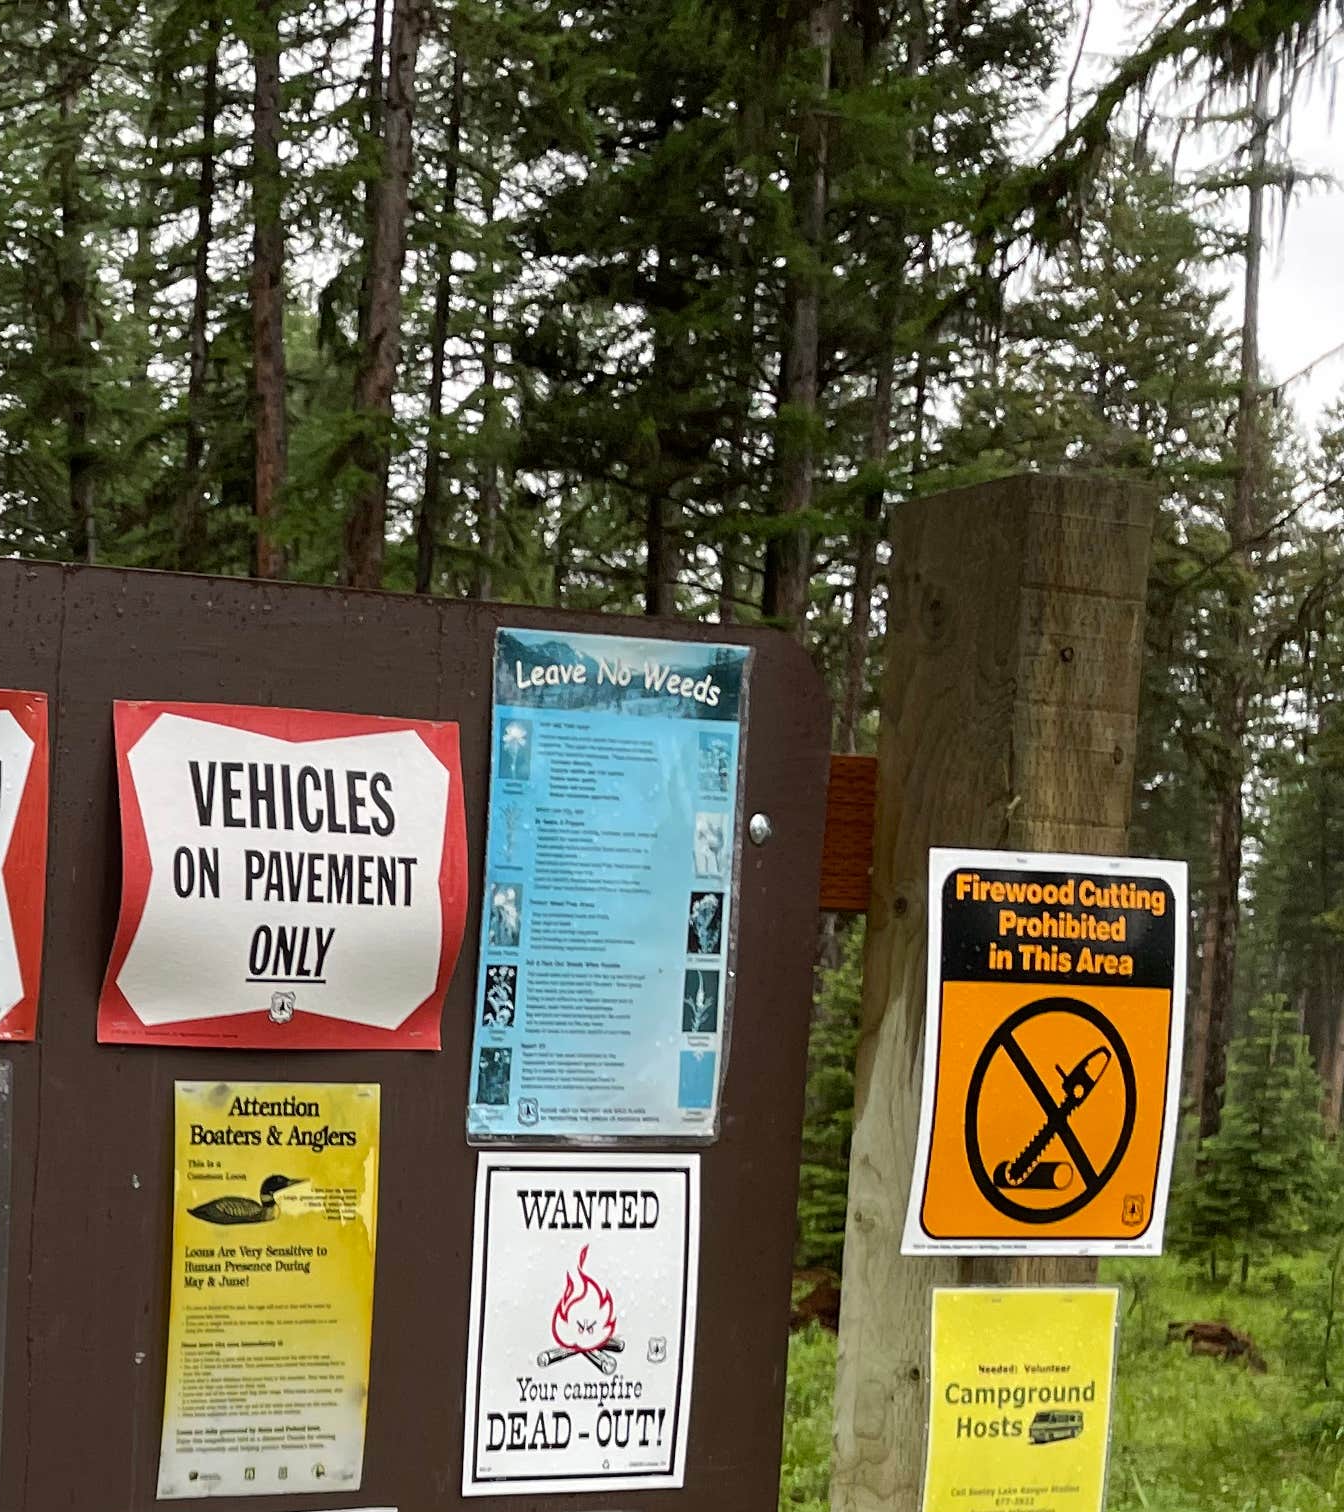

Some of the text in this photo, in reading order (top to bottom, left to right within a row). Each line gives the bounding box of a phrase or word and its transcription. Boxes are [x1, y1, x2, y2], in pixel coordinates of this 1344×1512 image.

[517, 658, 721, 706] Leave No Weeds
[189, 761, 395, 836] VEHICLES
[174, 847, 417, 906] ON PAVEMENT
[957, 874, 1165, 915] Firewood Cutting
[999, 910, 1125, 941] Prohibited
[250, 925, 335, 977] ONLY
[989, 943, 1133, 975] in This Area
[229, 1096, 319, 1117] Attention
[191, 1125, 356, 1152] Boaters & Anglers
[517, 1190, 659, 1229] WANTED
[517, 1375, 642, 1407] Your campfire
[946, 1381, 1095, 1408] Campground
[957, 1417, 1022, 1438] Hosts
